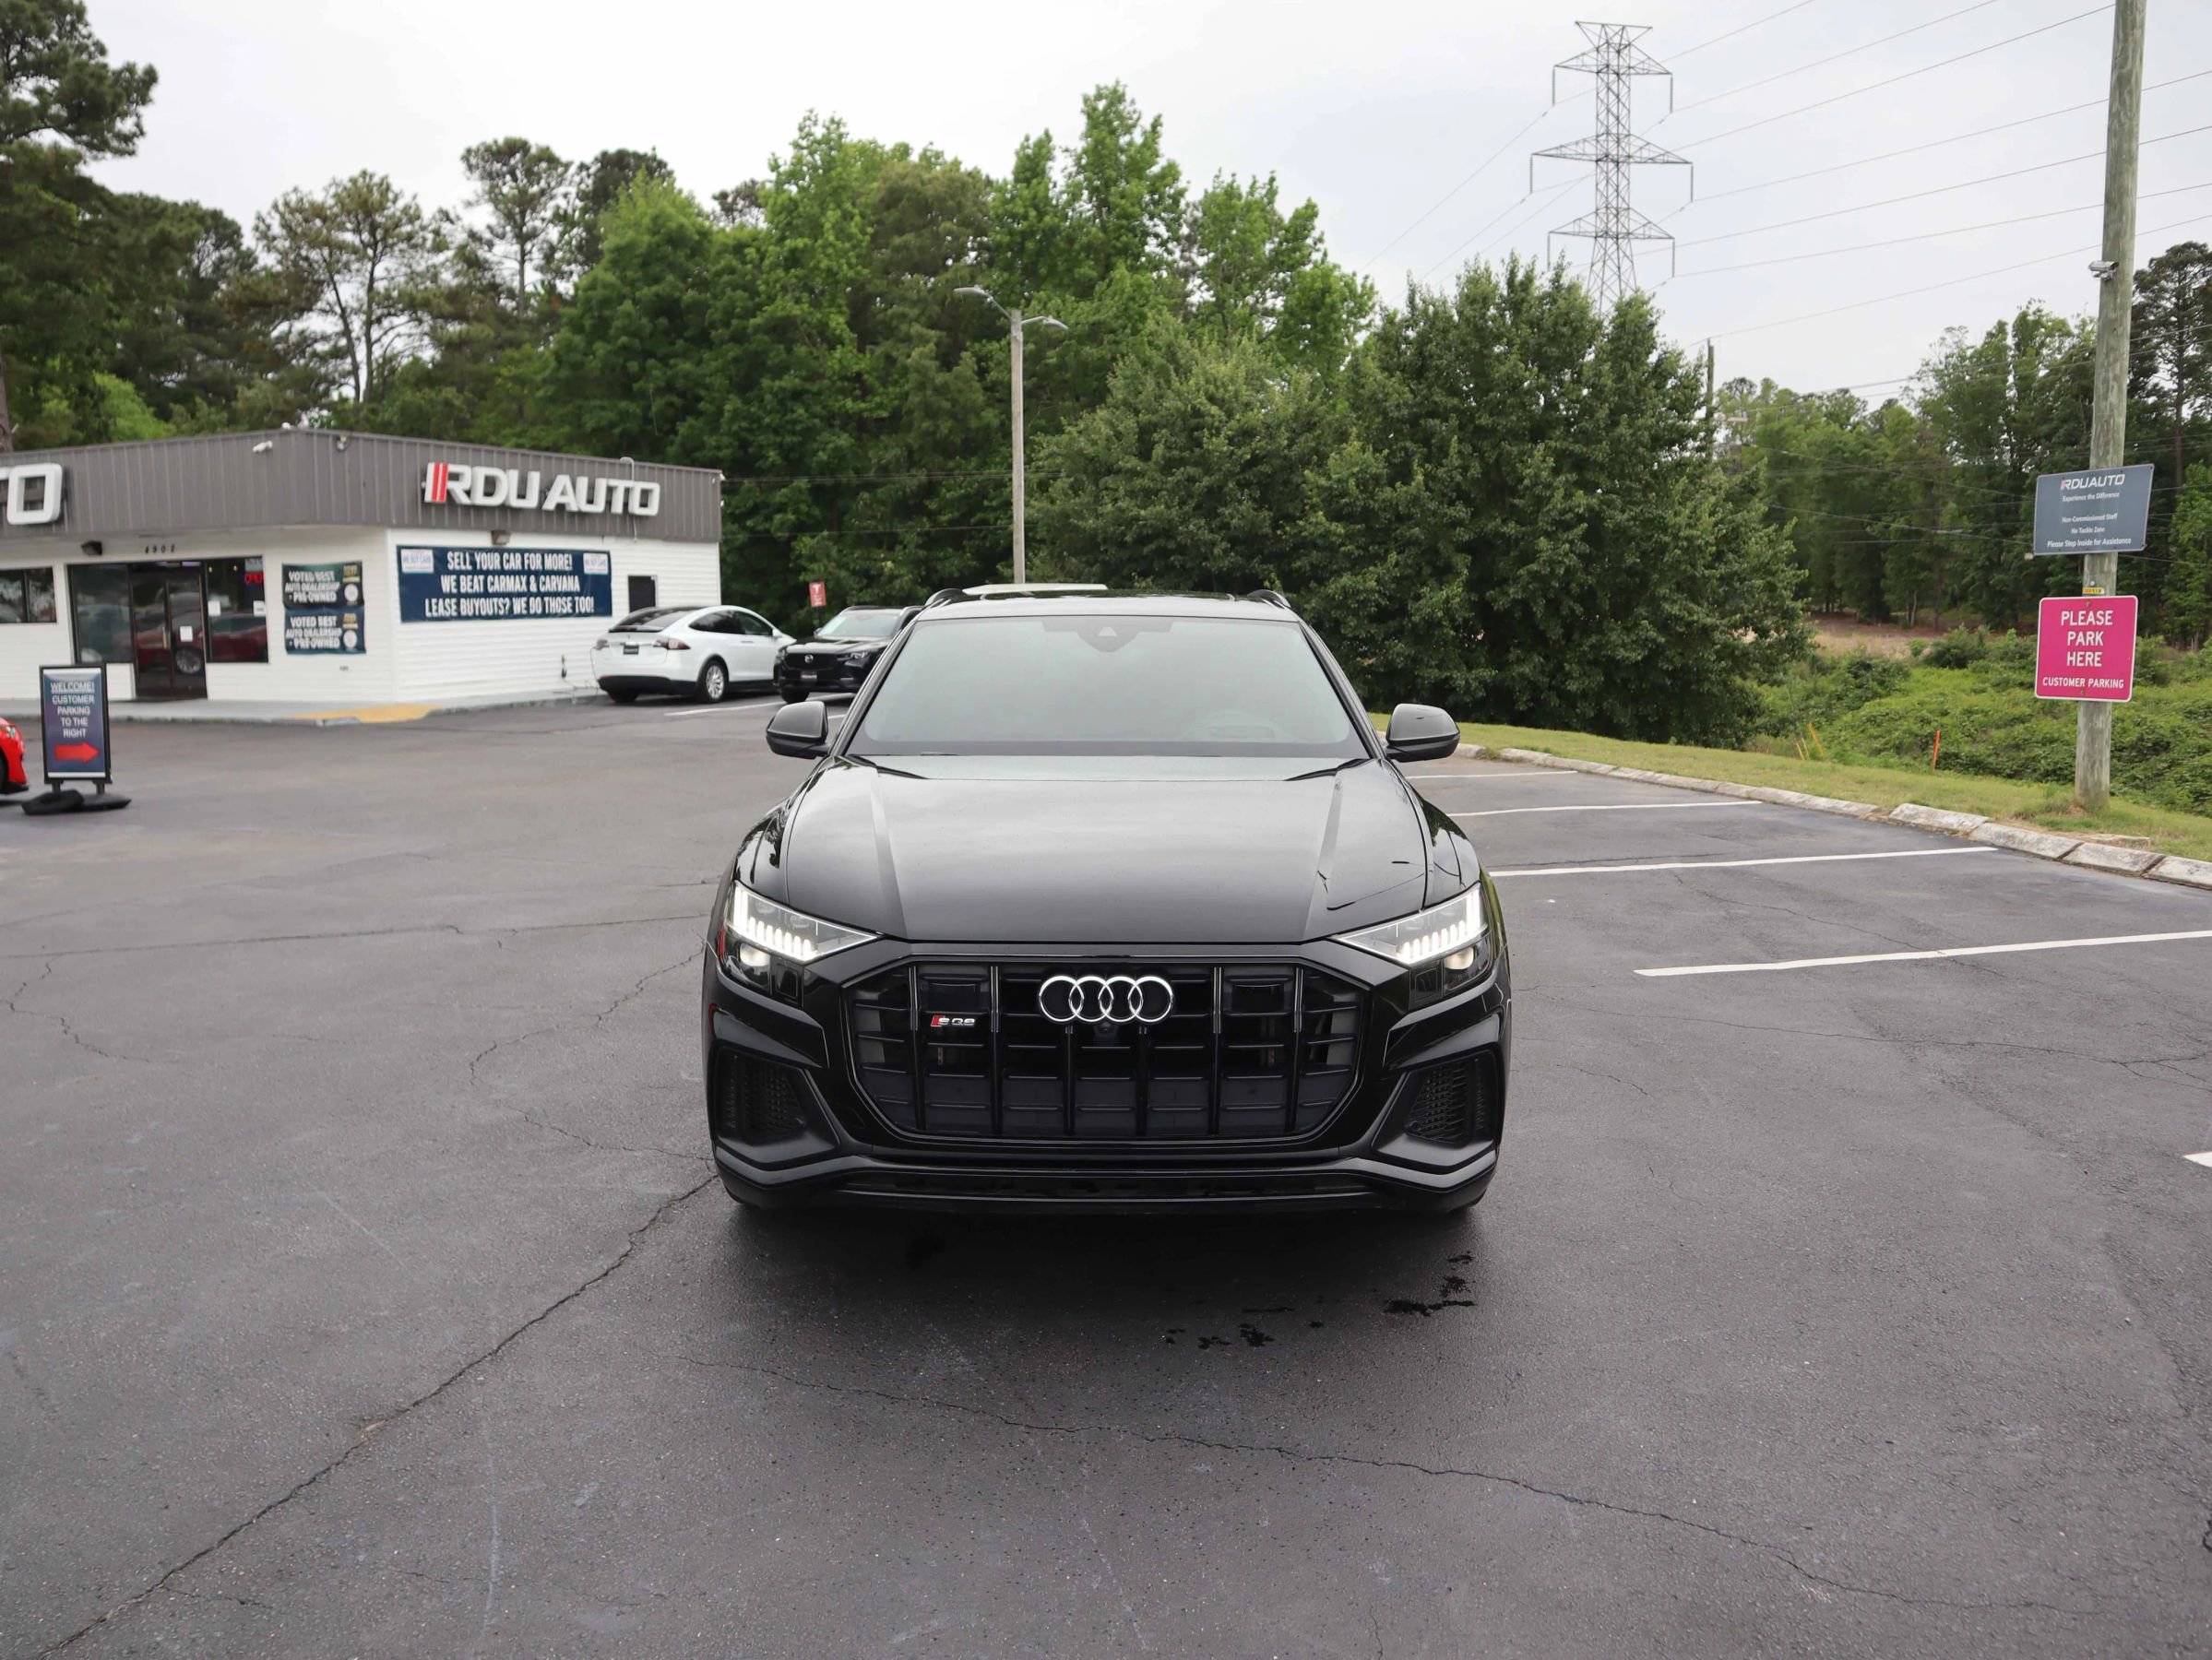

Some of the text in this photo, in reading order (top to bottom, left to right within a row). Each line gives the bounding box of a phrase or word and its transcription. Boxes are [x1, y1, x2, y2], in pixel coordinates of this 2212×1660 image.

[541, 474, 660, 516] AUTO
[2063, 494, 2086, 503] Experience
[2096, 492, 2120, 500] Difference
[2062, 514, 2105, 523] Non-Commissioned
[2064, 540, 2076, 548] Step
[447, 551, 472, 570] SELL
[475, 551, 501, 570] YOUR
[502, 552, 522, 570] CAR
[524, 552, 542, 570] FOR
[544, 553, 573, 571] MORE!
[288, 570, 315, 582] VOTED
[315, 570, 335, 582] BEST
[285, 582, 340, 592] AUTO DEALERSHIP
[440, 575, 580, 594] WE BEAT CARMAX & CARVANA
[425, 596, 594, 617] LEASE BUYOUTS? WE DO THOSE TOO!
[291, 616, 316, 628] VOTED
[317, 615, 337, 627] BEST
[2061, 611, 2113, 625] PLEASE
[286, 627, 342, 639] AUTO DEALERSHIP
[2067, 631, 2104, 646] PARK
[2066, 651, 2102, 667] HERE
[51, 682, 94, 693] WELCOME!
[2042, 677, 2124, 689] CUSTOMER PARKING
[52, 694, 94, 706] CUSTOMER
[57, 706, 90, 716] PARKING
[61, 717, 89, 727] TO THE
[63, 728, 87, 738] RIGHT
